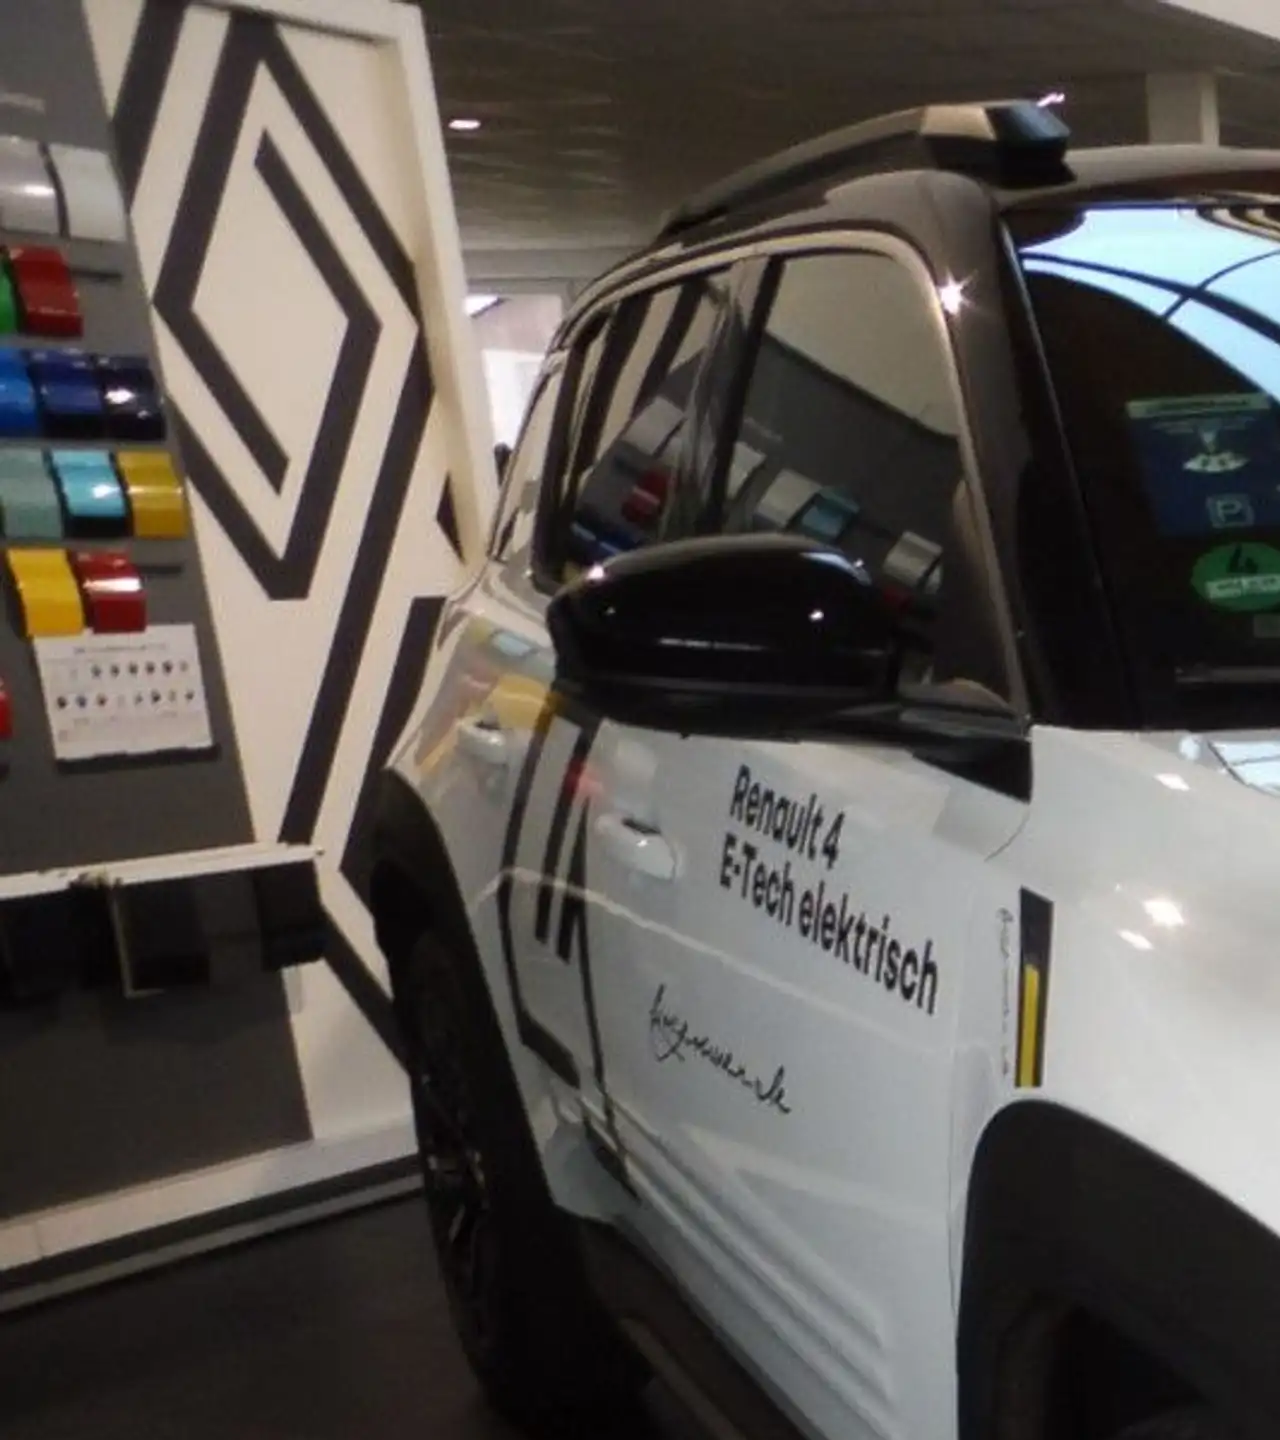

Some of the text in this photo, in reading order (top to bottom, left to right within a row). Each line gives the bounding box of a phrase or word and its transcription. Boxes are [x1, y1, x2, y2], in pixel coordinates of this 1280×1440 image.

[730, 764, 845, 870] Renault 4
[720, 832, 794, 926] E-Tech
[799, 880, 938, 1016] elektrisch
